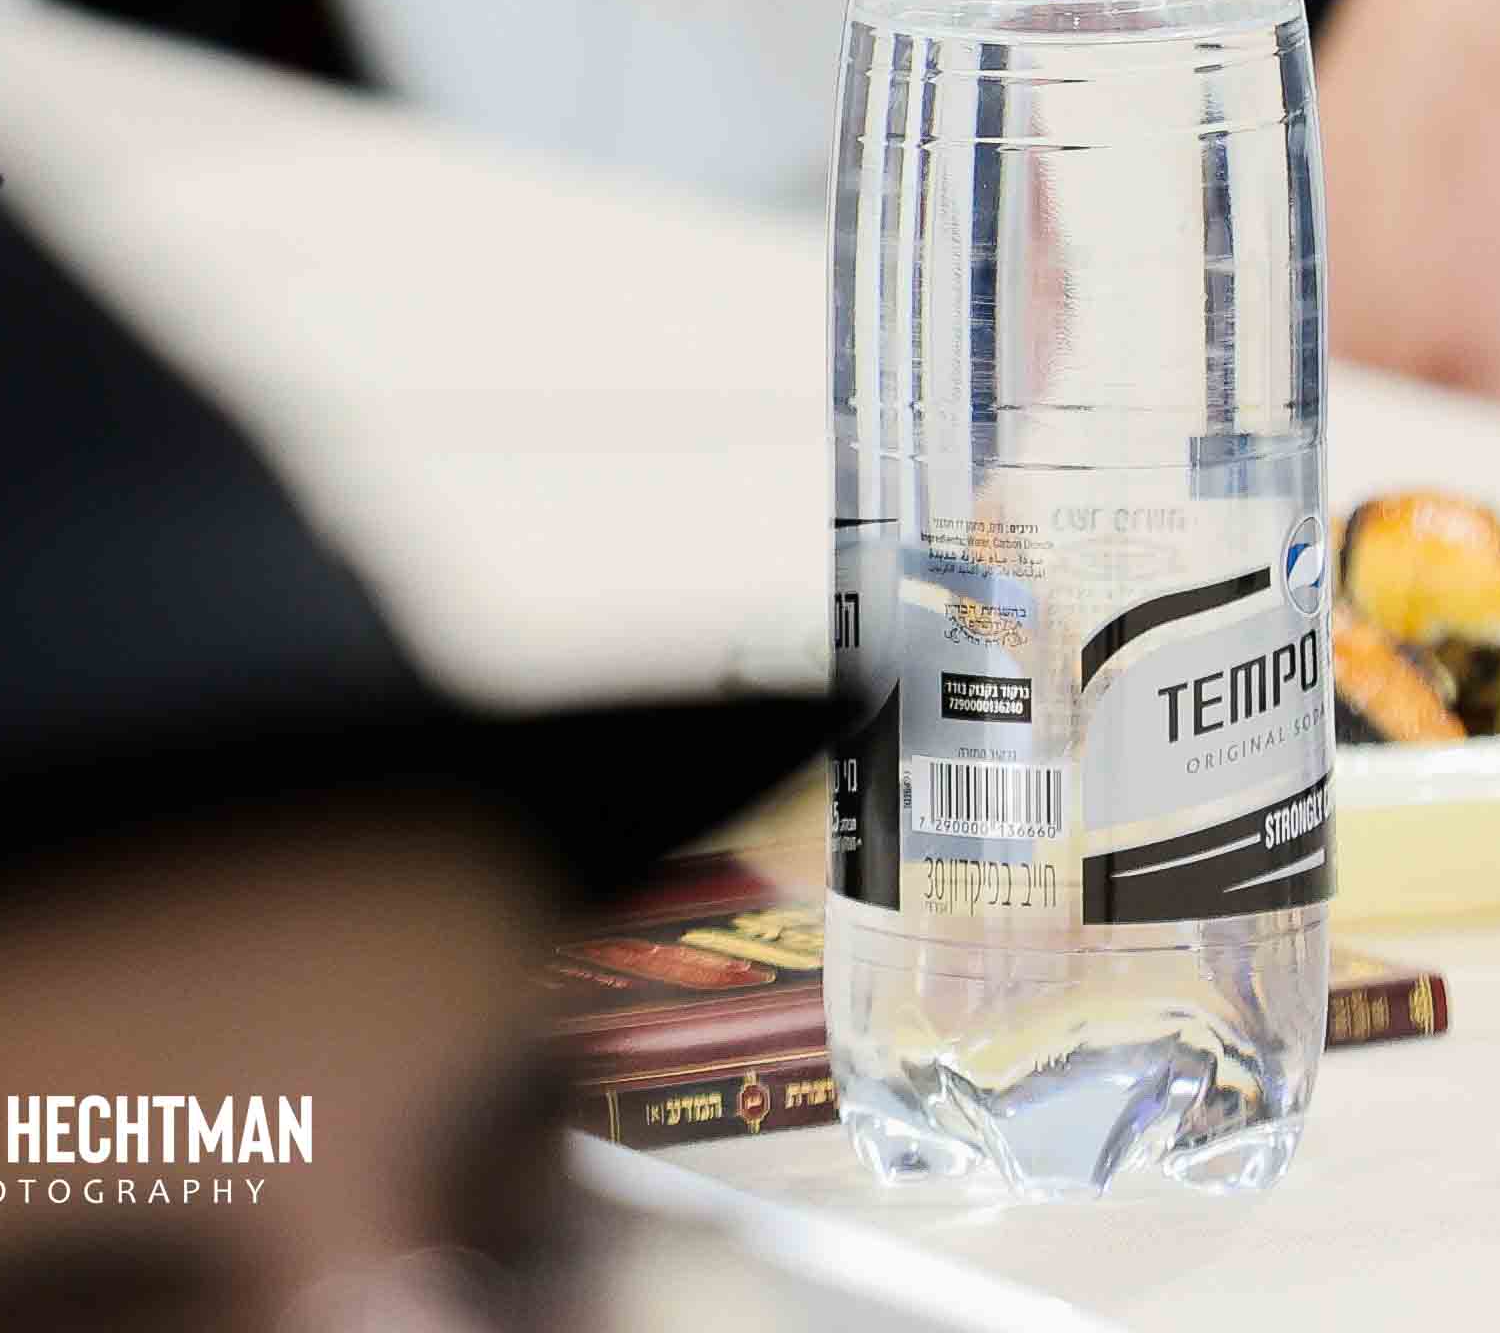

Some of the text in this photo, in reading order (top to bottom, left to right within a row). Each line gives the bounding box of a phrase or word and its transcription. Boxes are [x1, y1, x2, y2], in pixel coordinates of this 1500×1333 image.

[999, 684, 1030, 700] ברקוד
[1158, 629, 1318, 743] TEMPO
[1186, 726, 1286, 774] ORIGINAL
[1264, 787, 1323, 850] STRONGLY
[924, 856, 1056, 917] חייב בפיקדון 30
